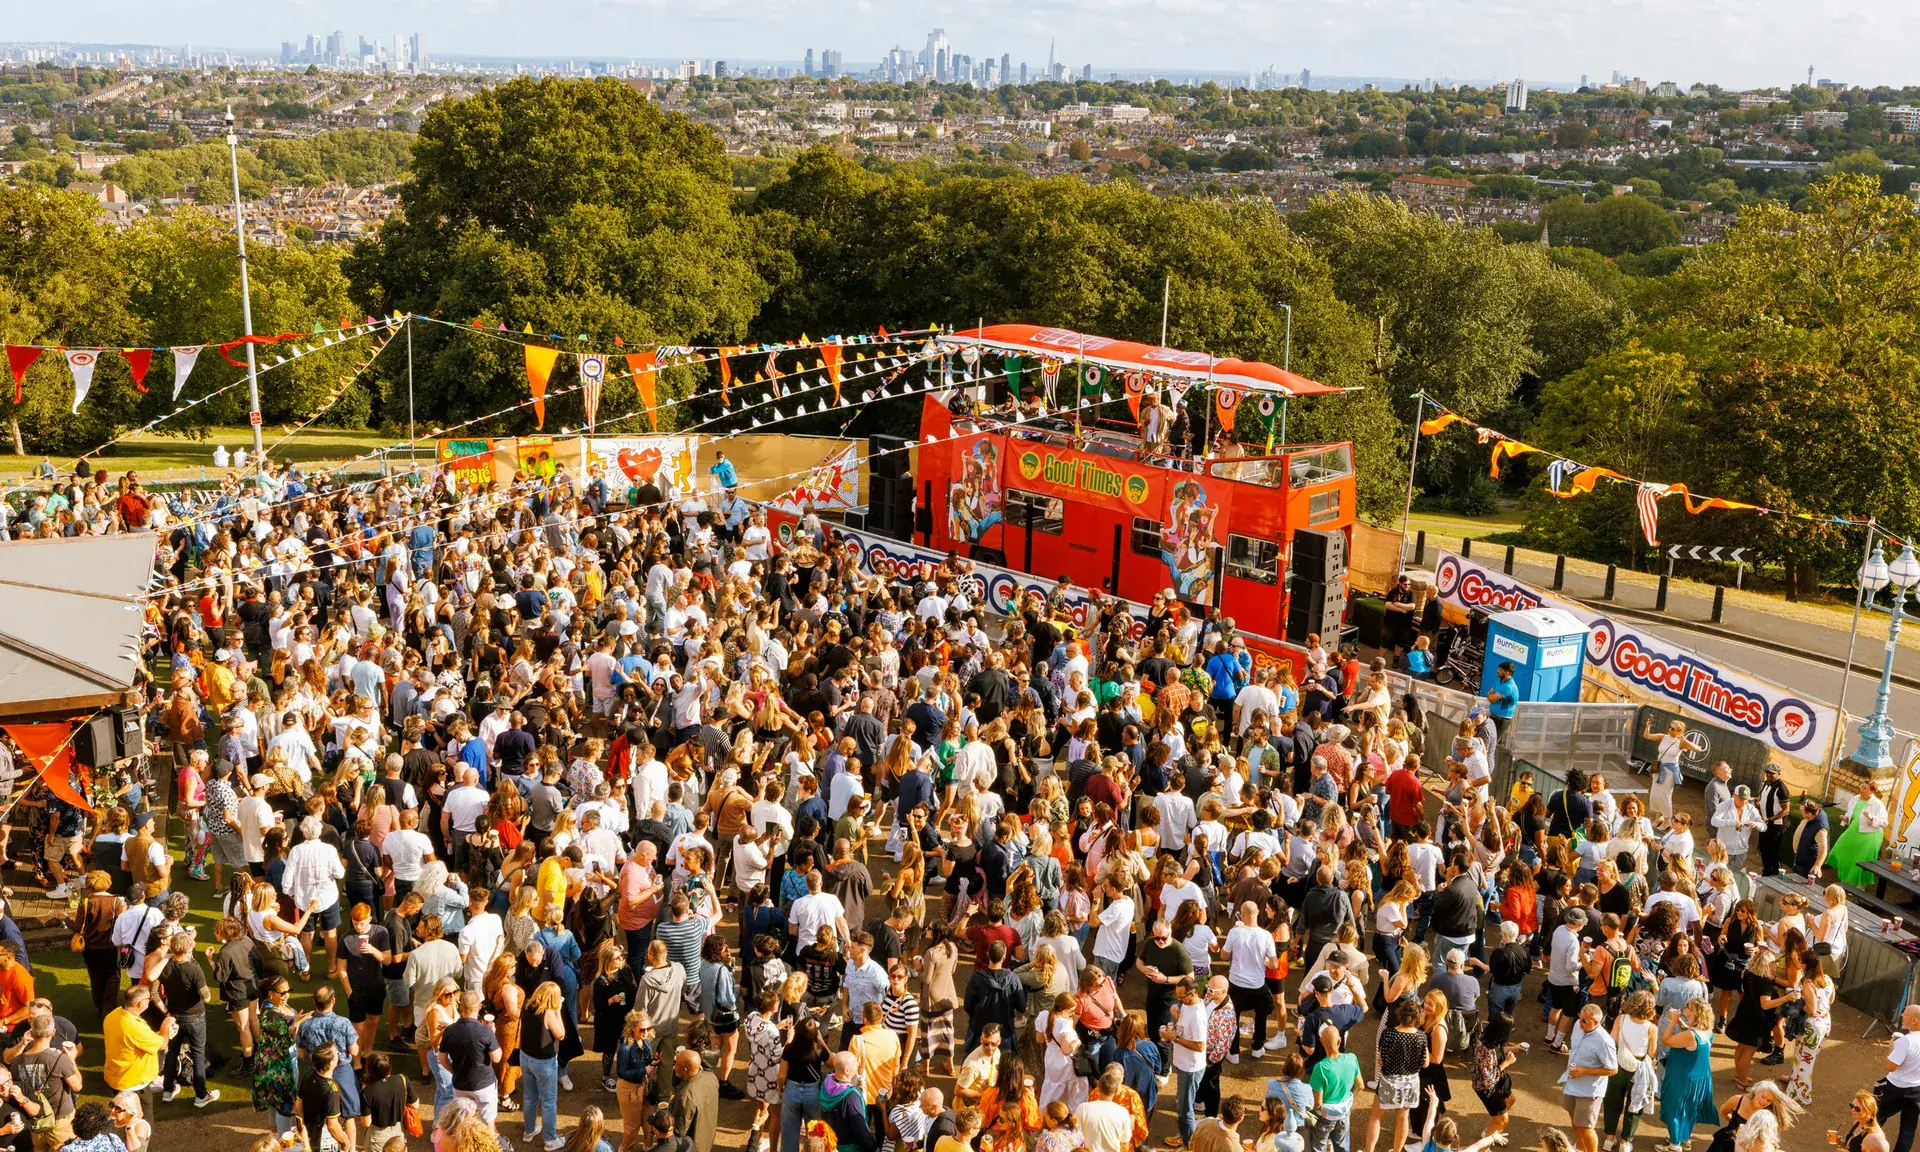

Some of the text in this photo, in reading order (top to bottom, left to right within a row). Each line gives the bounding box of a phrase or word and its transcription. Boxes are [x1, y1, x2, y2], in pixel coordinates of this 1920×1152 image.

[1044, 454, 1122, 497] Good Times
[1615, 641, 1764, 727] Good Times
